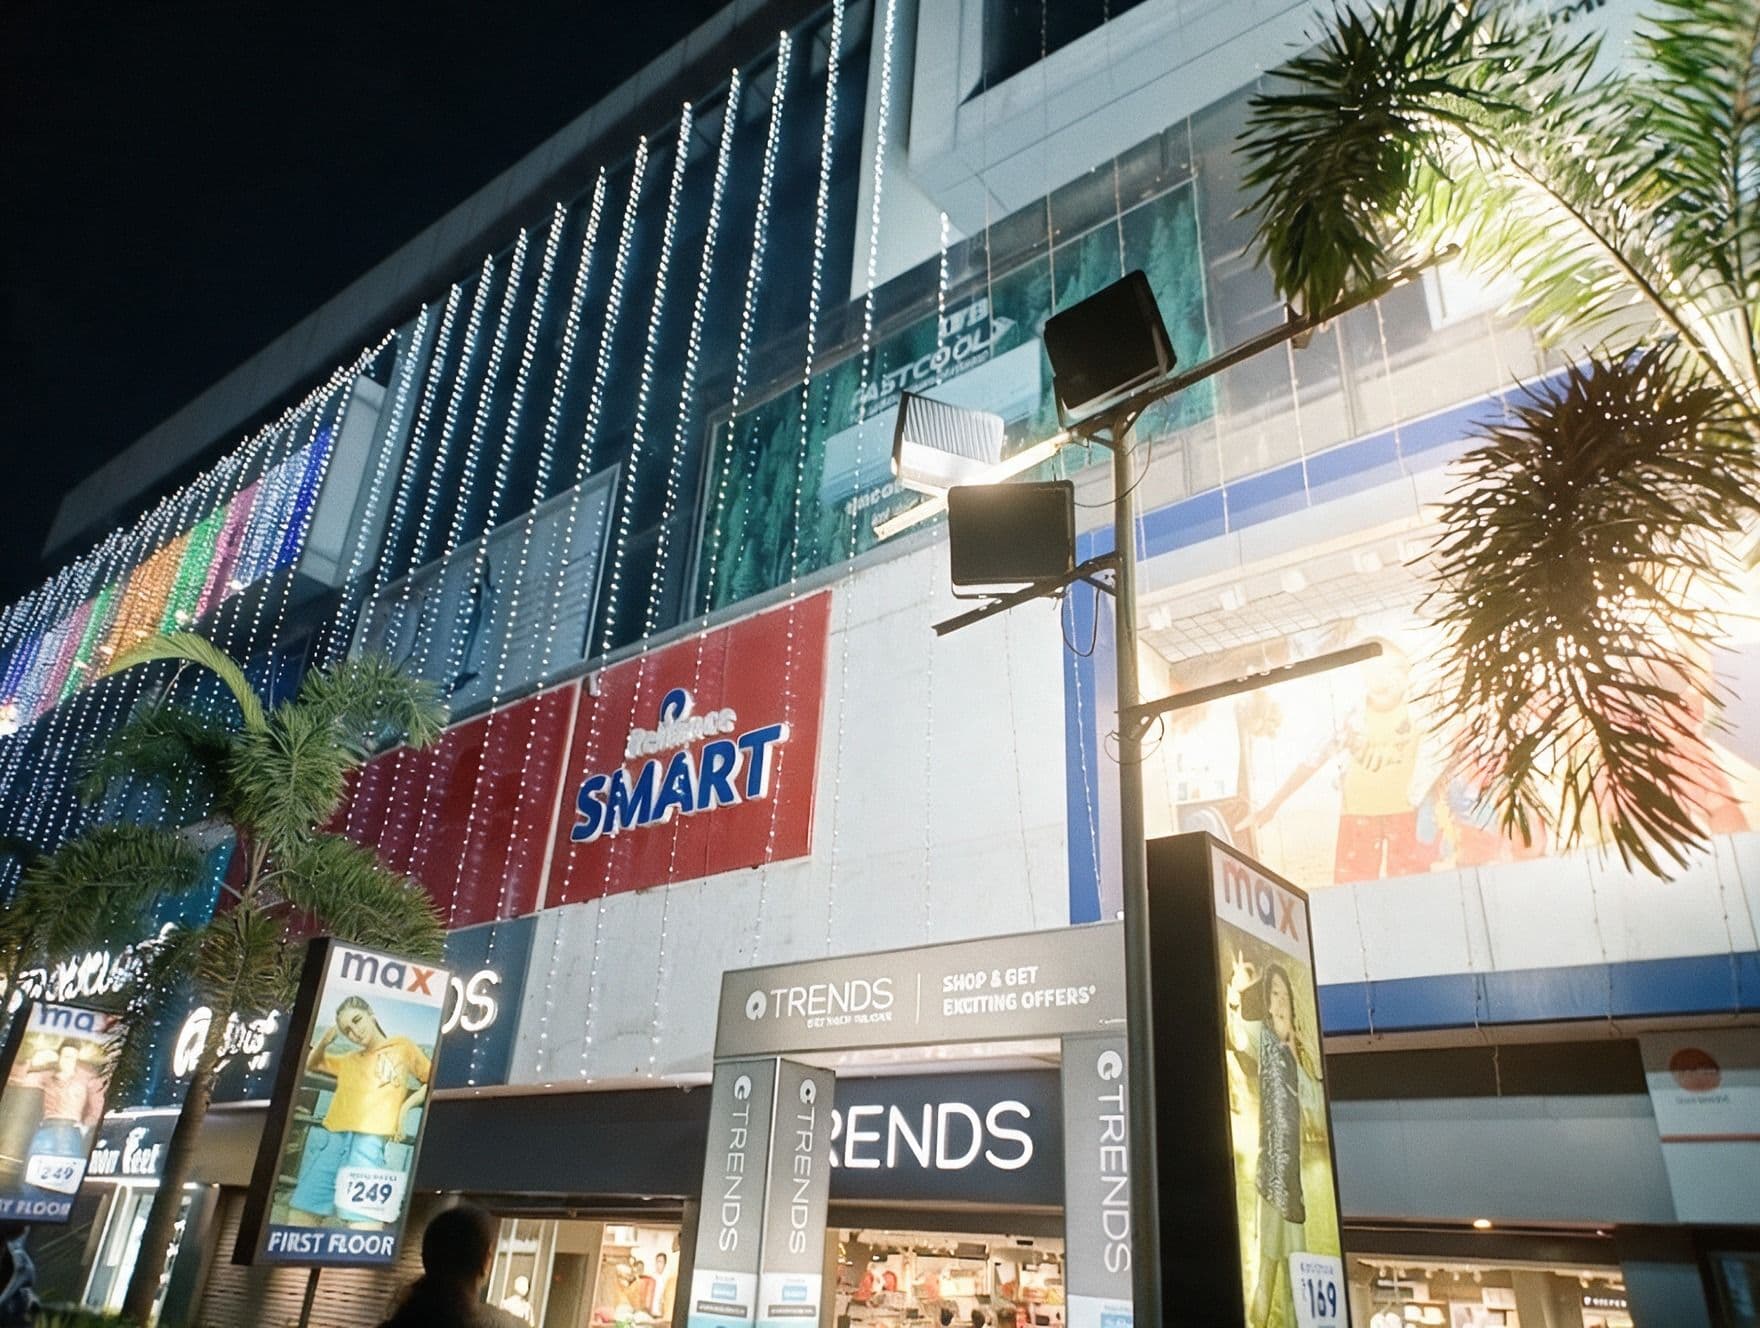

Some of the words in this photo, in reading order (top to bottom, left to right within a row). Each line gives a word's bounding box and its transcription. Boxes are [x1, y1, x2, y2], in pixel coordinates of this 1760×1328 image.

[570, 721, 790, 843] SMART
[1222, 860, 1300, 942] max
[340, 951, 434, 996] max
[770, 977, 894, 1018] TRENDS
[942, 971, 987, 992] SHOP
[990, 969, 1002, 988] &
[1005, 966, 1039, 985] GET
[943, 993, 1017, 1016] EXCITING
[718, 1103, 750, 1252] TRENDS
[789, 1106, 815, 1254] TRENDS
[1098, 1084, 1131, 1273] TRENDS
[267, 1231, 324, 1253] FIRST
[327, 1233, 394, 1256] FLOOR
